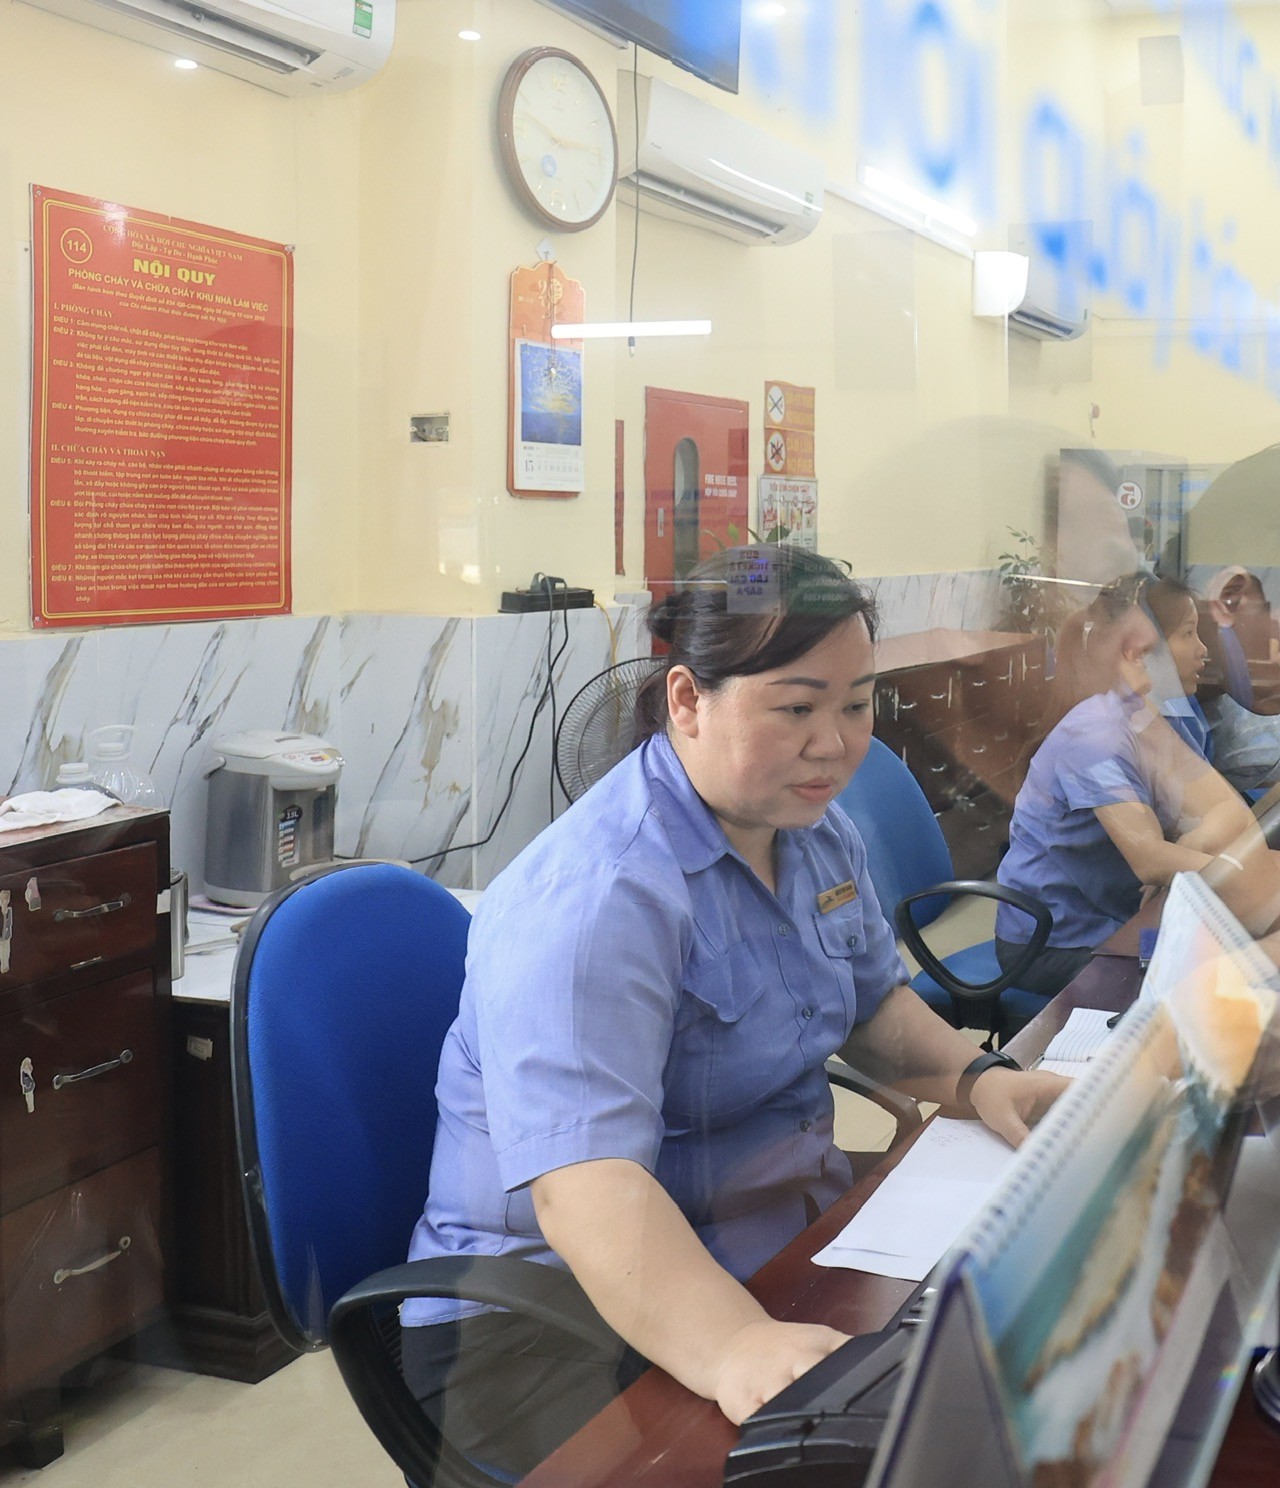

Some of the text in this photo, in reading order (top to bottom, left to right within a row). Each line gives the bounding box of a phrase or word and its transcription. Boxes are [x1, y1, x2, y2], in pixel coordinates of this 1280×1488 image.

[67, 239, 86, 252] 114
[68, 268, 101, 281] PHÒNG
[104, 274, 128, 285] CHÁY
[130, 279, 143, 289] VÀ
[145, 282, 170, 293] CHỮA
[171, 287, 194, 297] CHÁY
[196, 292, 213, 301] KHU
[133, 259, 214, 285] NỘI QUY
